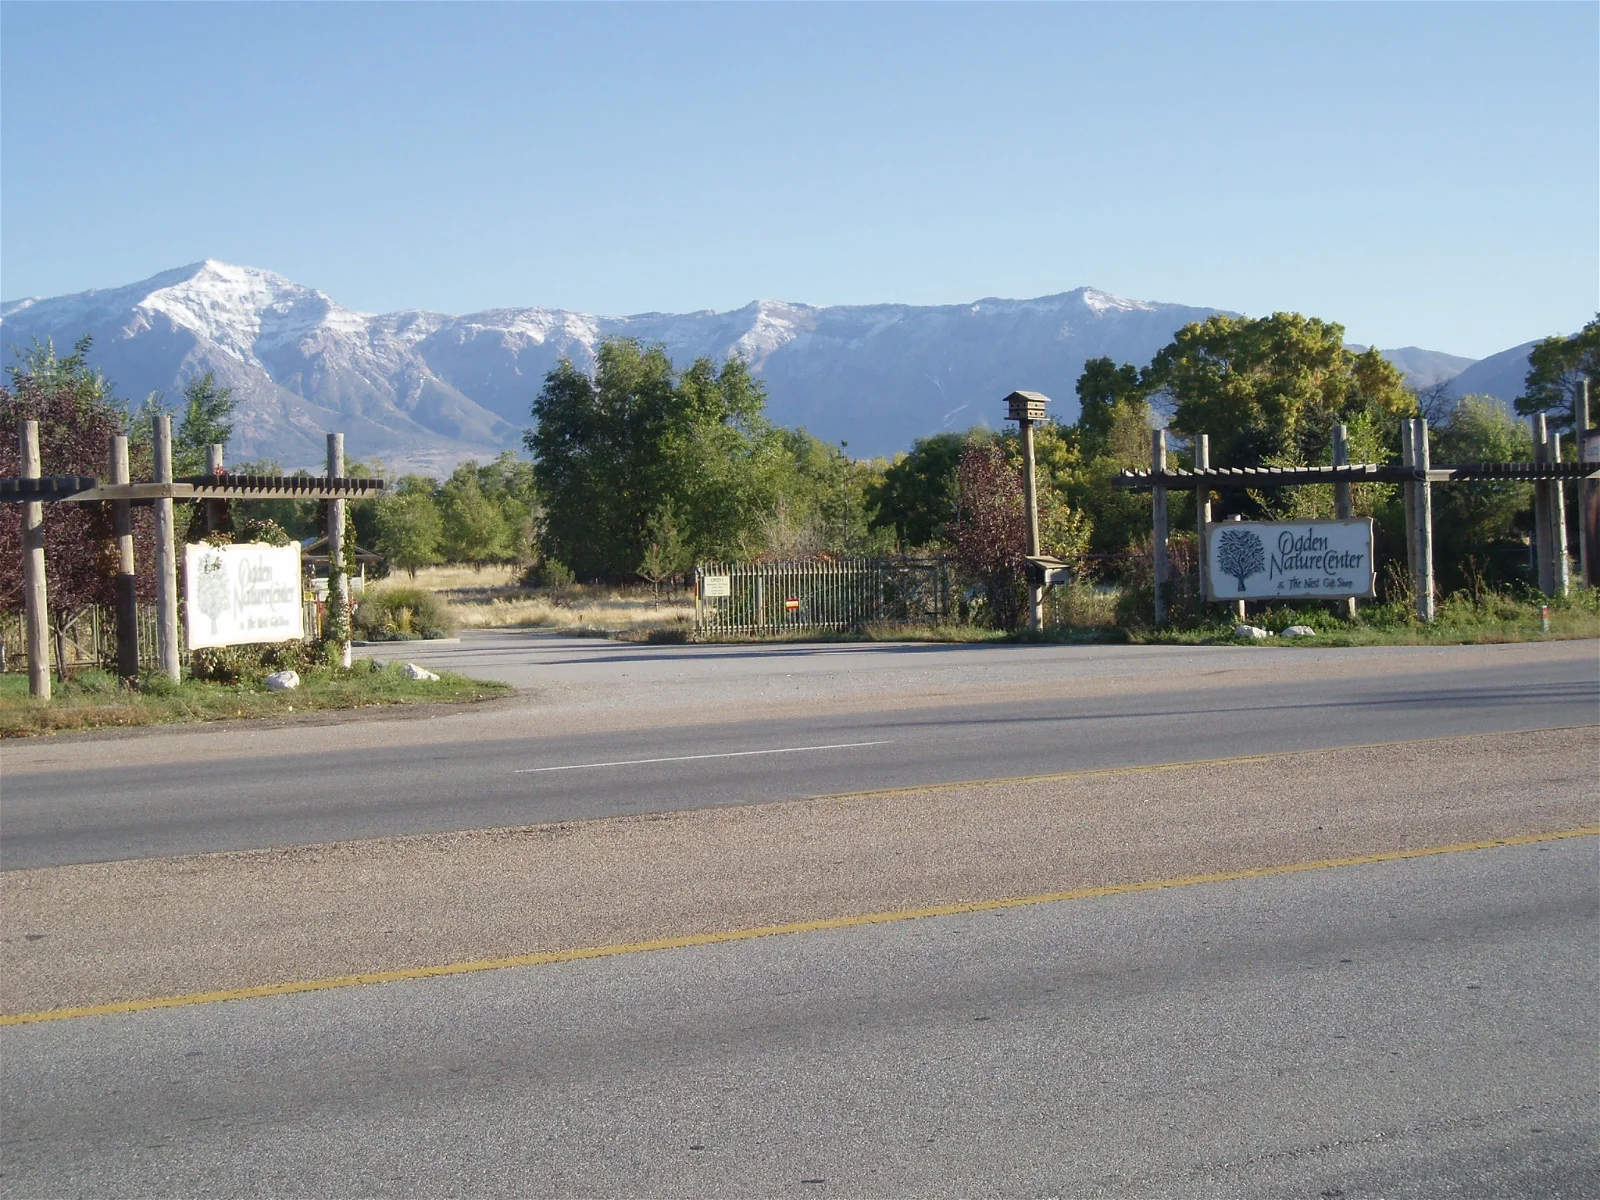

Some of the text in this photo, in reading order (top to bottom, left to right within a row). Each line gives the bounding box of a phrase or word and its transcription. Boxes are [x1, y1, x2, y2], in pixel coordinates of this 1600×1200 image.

[1278, 527, 1328, 555] Ogden
[238, 553, 272, 589] Ogden
[1288, 576, 1302, 590] The
[1304, 577, 1320, 589] Nest
